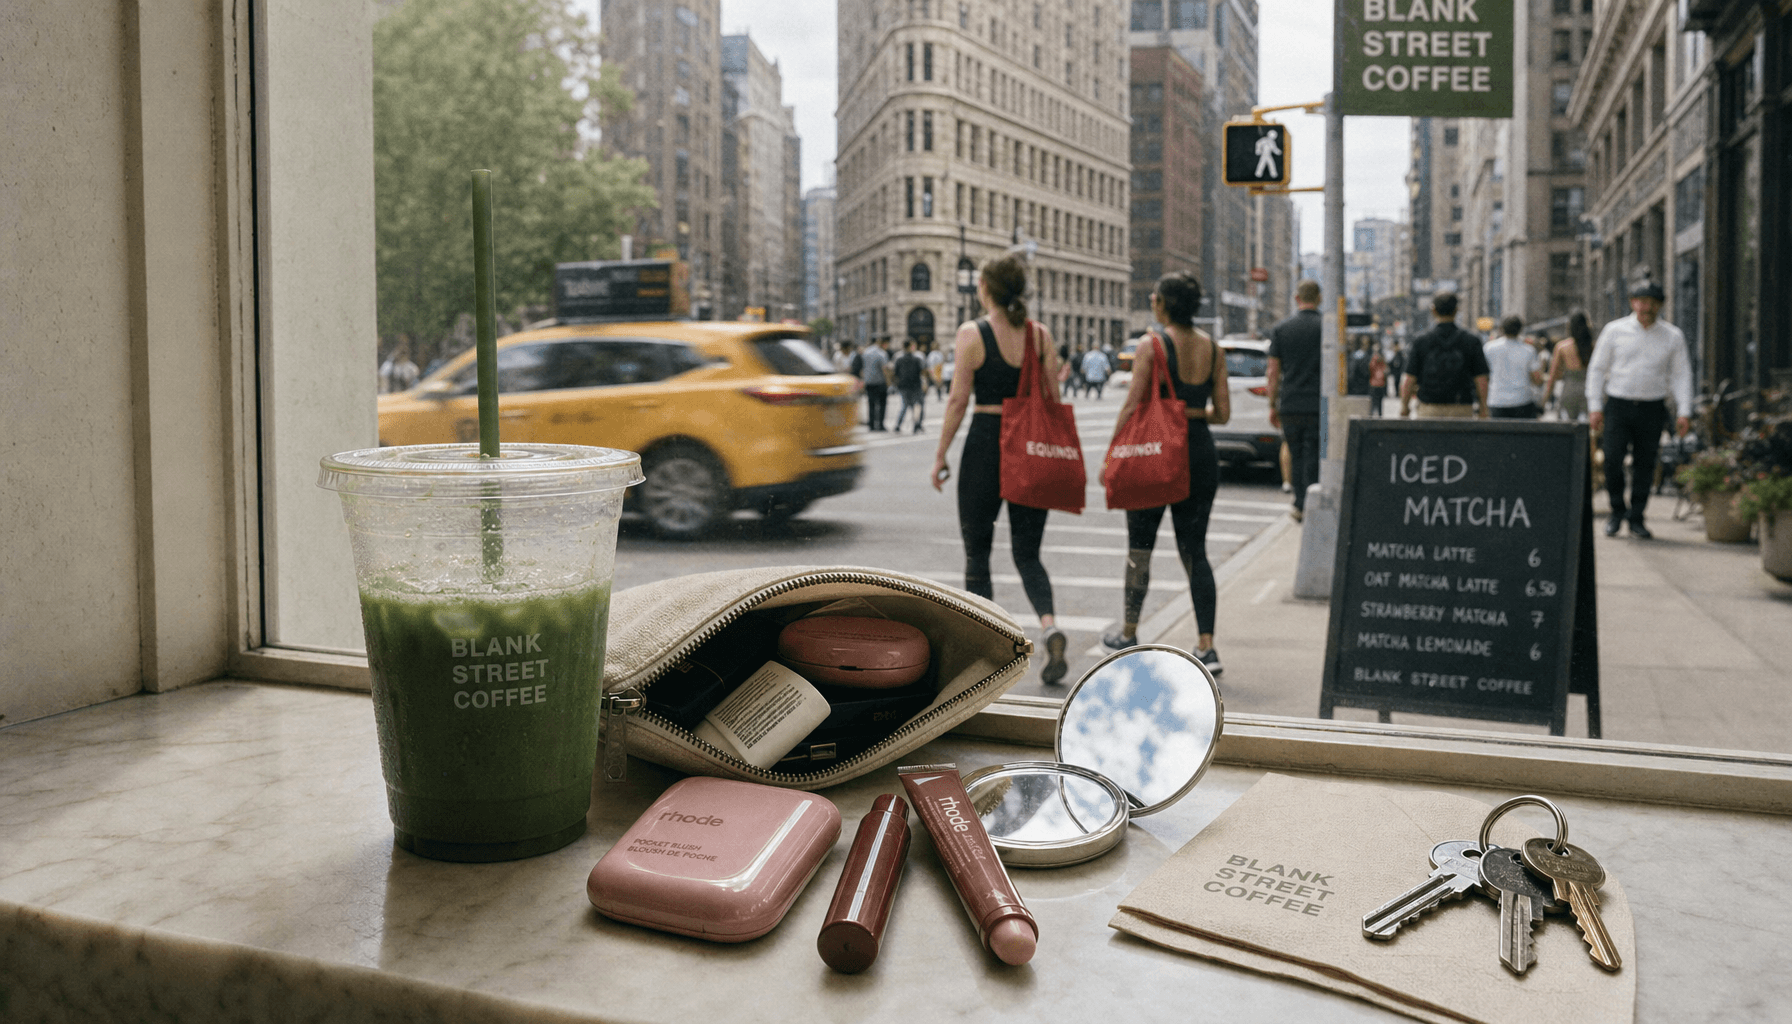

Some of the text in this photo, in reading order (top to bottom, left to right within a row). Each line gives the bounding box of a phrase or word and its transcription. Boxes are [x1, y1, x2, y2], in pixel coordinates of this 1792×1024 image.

[1364, 0, 1479, 22] BLANK
[1363, 30, 1492, 57] STREET
[1362, 64, 1491, 91] COFFEE
[1390, 453, 1468, 484] ICED
[1403, 496, 1531, 528] MATCHA
[1366, 542, 1542, 568] MATCHA LATTE 6
[1364, 571, 1557, 597] OAT MATCHA LATTE 6.50
[1360, 601, 1545, 629] STRAWBERRY MATCHA 7
[451, 633, 542, 657] BLANK
[1357, 631, 1542, 661] MATCHA LEMONADE 6
[452, 659, 549, 684] STREET
[1354, 667, 1533, 695] BLANK STREET COFFEE
[453, 684, 546, 709] COFFEE
[658, 811, 724, 827] rhode
[938, 796, 971, 832] rhode
[633, 838, 702, 851] POCKET BLUSH
[682, 851, 718, 862] POCHE
[1215, 867, 1335, 901] STREET
[1226, 854, 1334, 887] BLANK
[1203, 881, 1324, 917] COFFEE
